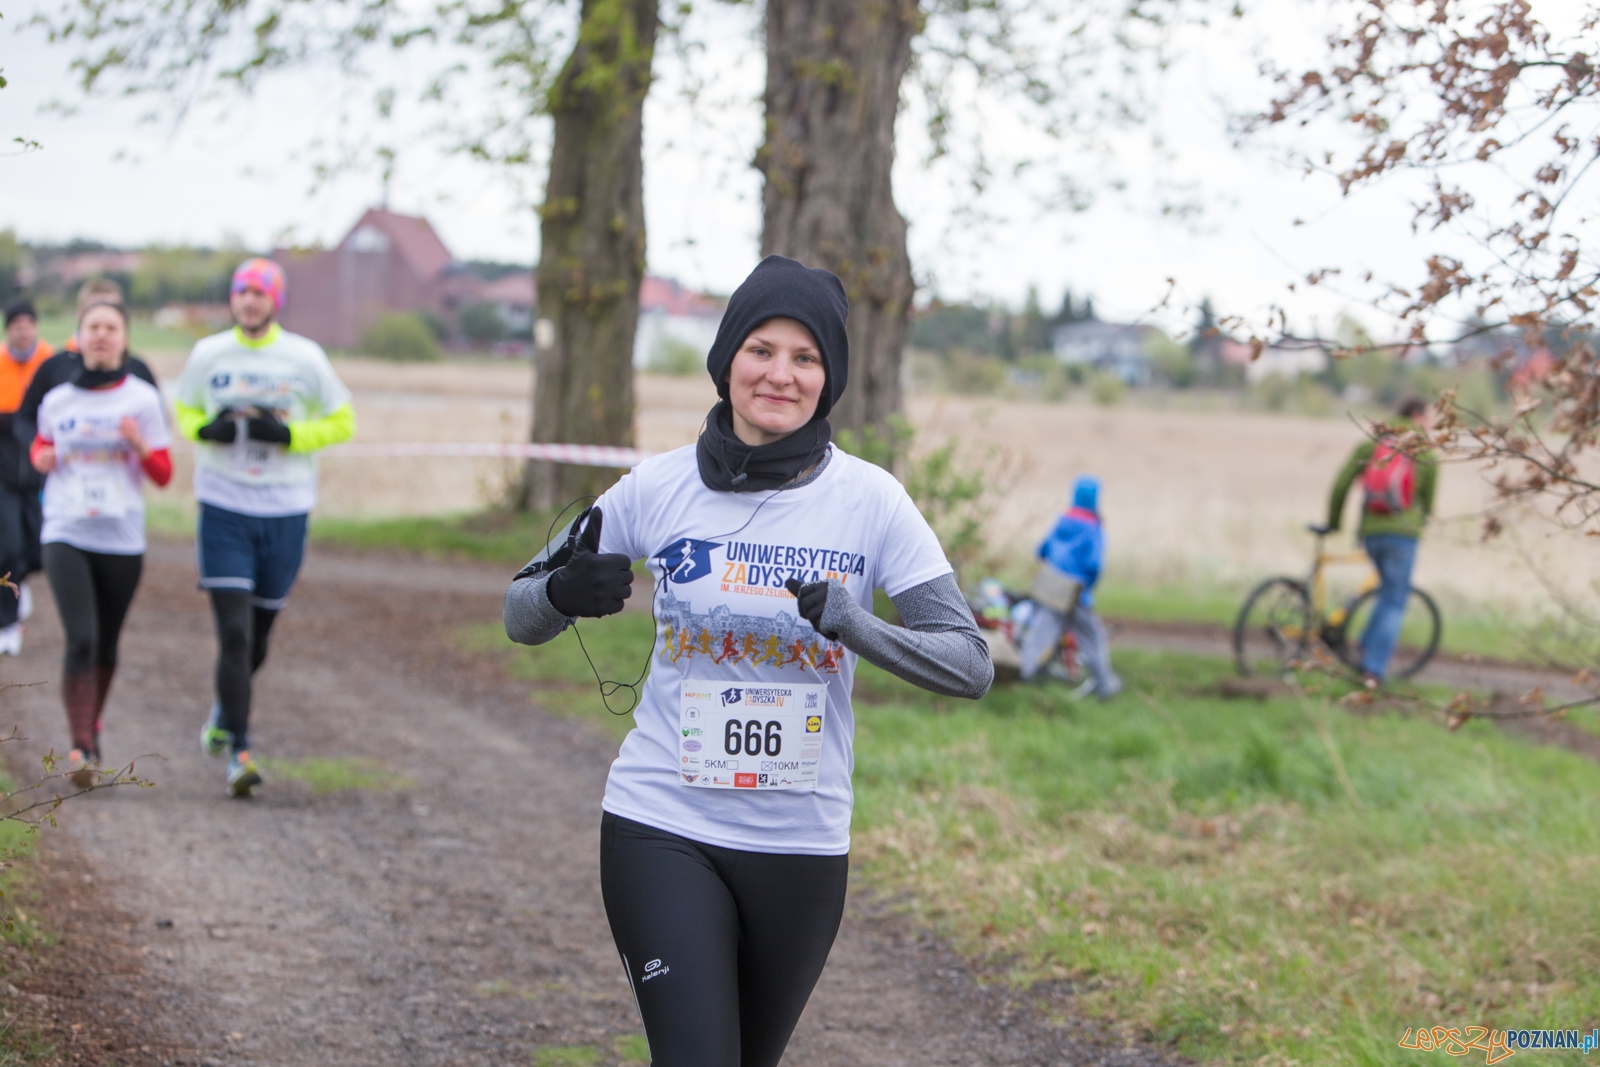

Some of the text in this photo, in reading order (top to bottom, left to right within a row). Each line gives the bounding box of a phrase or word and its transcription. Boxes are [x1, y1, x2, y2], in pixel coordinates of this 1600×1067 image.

[726, 541, 866, 576] UNIWERSYTECKA
[720, 583, 731, 593] IM.
[733, 585, 764, 596] JERZEGO
[745, 688, 792, 697] UNIWERSYTECKA
[744, 695, 776, 704] ZADYSZKA
[776, 697, 785, 707] IV
[724, 718, 783, 757] 666
[704, 759, 726, 769] 5KM
[773, 761, 799, 771] 10KM
